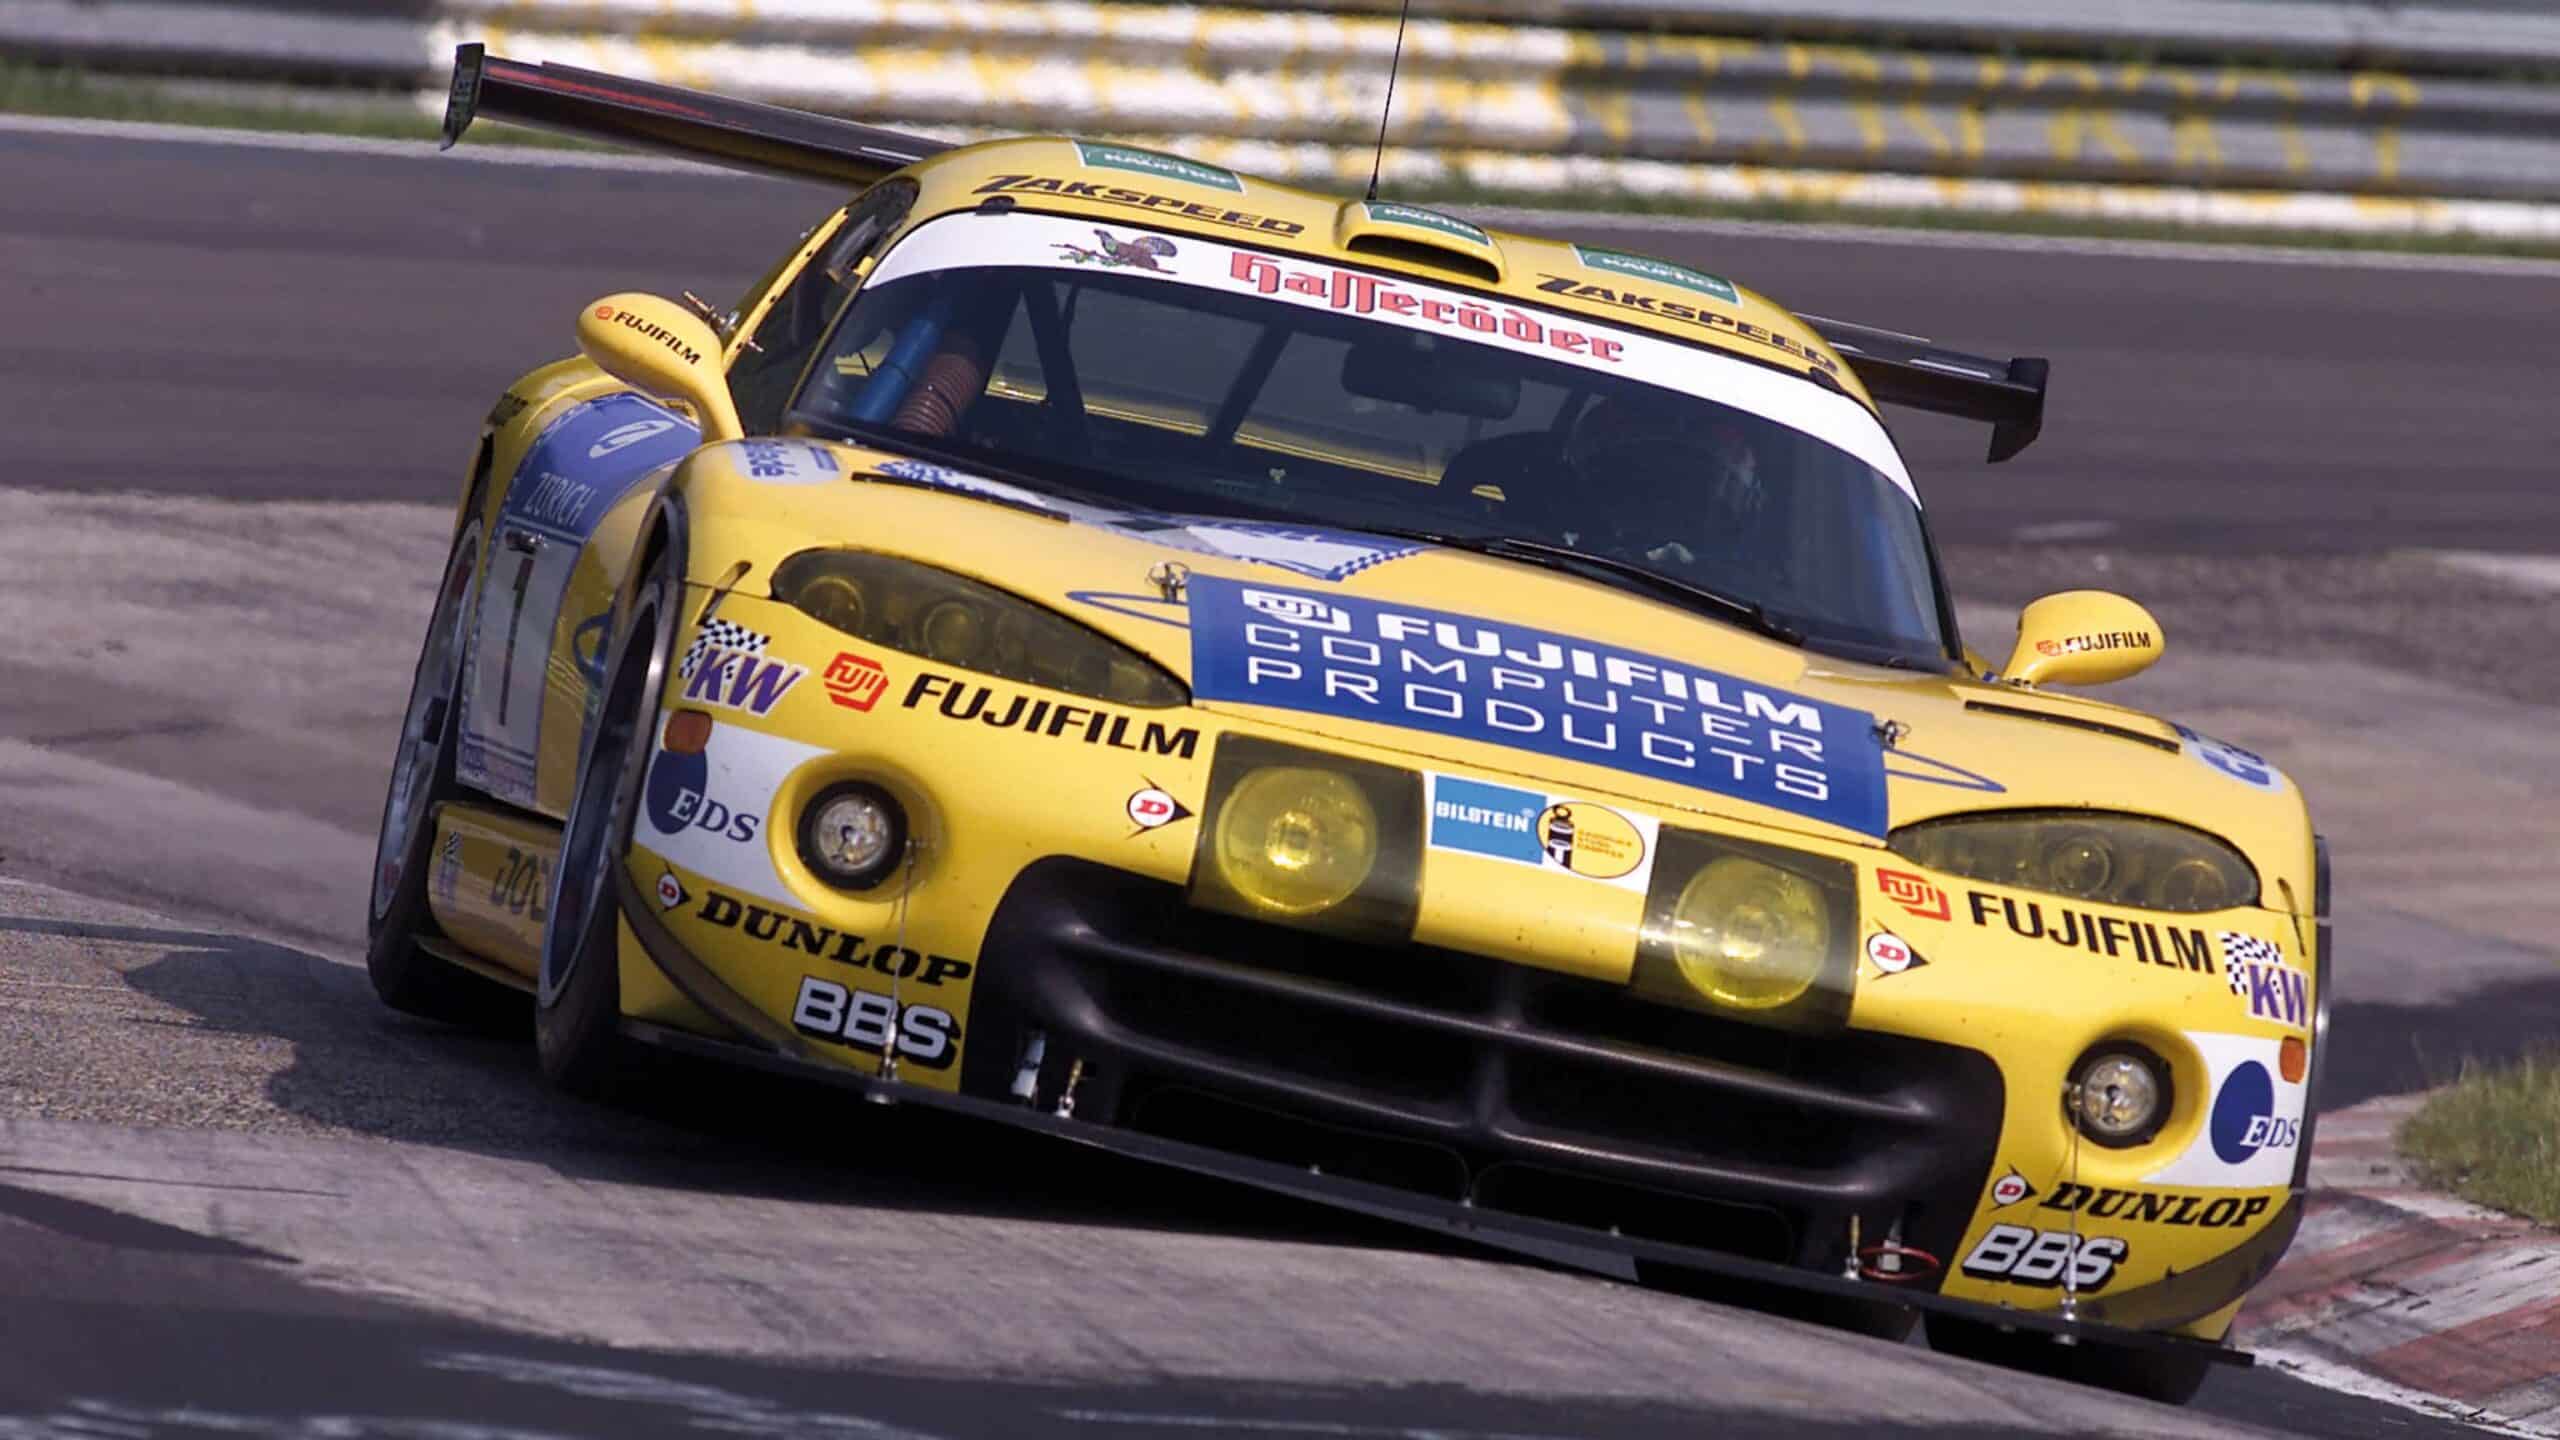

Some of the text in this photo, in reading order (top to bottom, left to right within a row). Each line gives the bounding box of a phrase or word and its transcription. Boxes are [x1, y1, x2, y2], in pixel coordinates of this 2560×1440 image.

[971, 175, 1305, 236] ZAKSPEED
[613, 311, 702, 365] FUJIFILM
[1536, 273, 1839, 373] ZAKSPEED
[684, 648, 804, 714] KW
[825, 655, 886, 704] FUJI
[1245, 623, 1825, 762] COMPUTER
[1377, 613, 1822, 731] FUJIFILM
[902, 673, 1200, 760] FUJIFILM
[1248, 656, 1829, 801] PRODUCTS
[668, 788, 760, 842] EDS
[1435, 801, 1530, 832] BILSTEIN
[696, 890, 973, 987] DUNLOP
[1968, 890, 2216, 974] FUJIFILM
[793, 976, 957, 1067] BBS
[2248, 963, 2309, 1027] KW
[2240, 1115, 2299, 1149] EDS
[2040, 1180, 2270, 1228] DUNLOP
[1962, 1223, 2128, 1293] BBS
